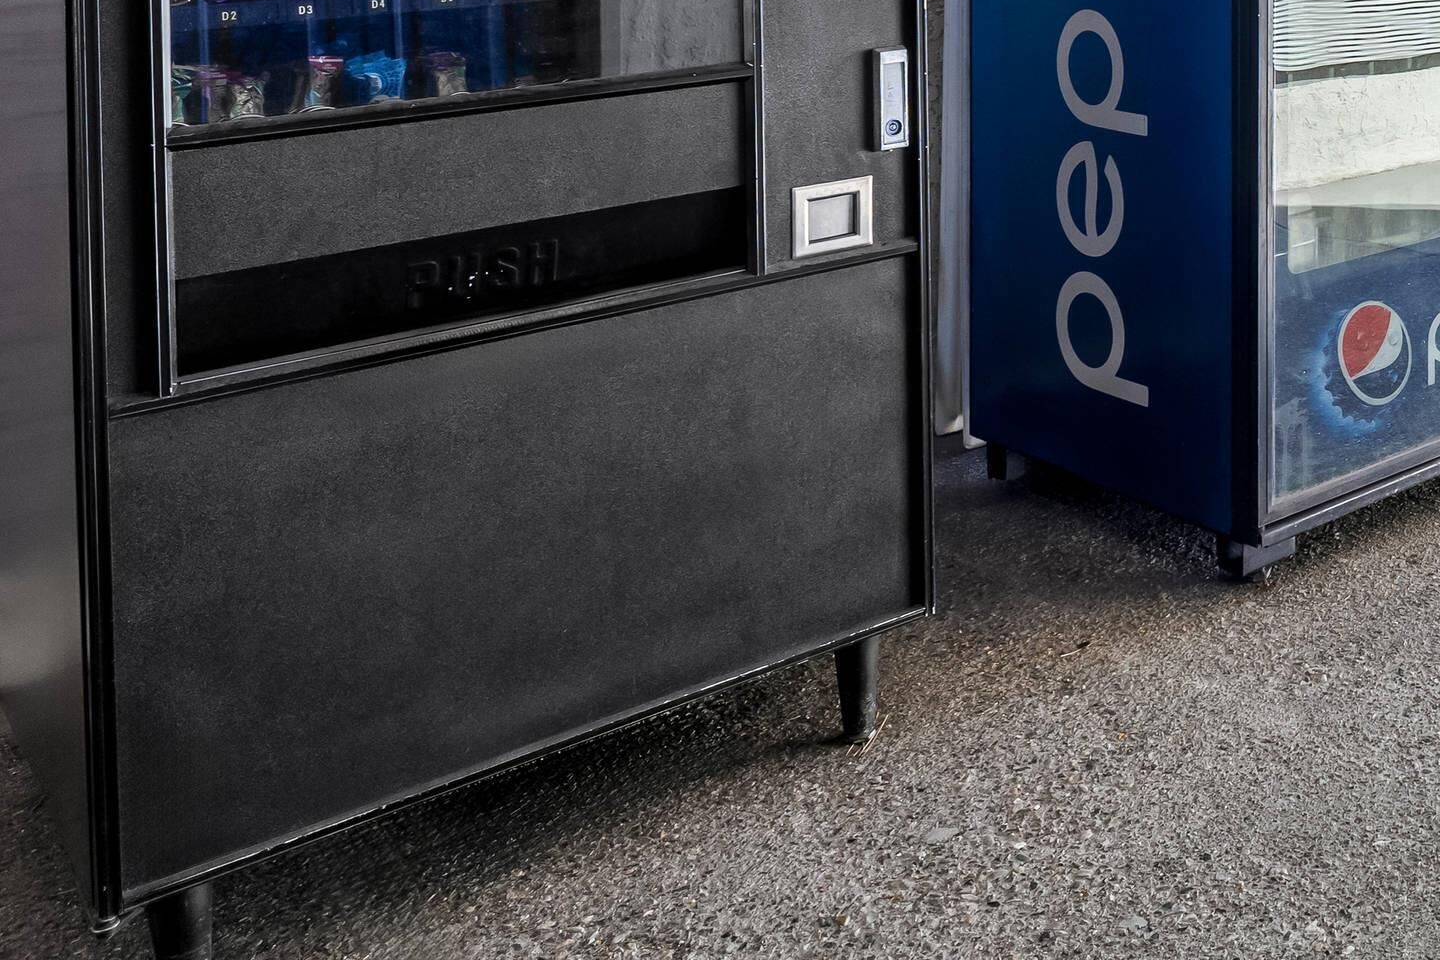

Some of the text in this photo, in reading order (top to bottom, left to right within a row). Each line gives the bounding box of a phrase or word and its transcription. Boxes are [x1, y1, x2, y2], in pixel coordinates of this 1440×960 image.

[371, 0, 385, 9] D4
[298, 5, 313, 15] D3
[222, 11, 237, 21] D2
[407, 239, 558, 310] PUSH
